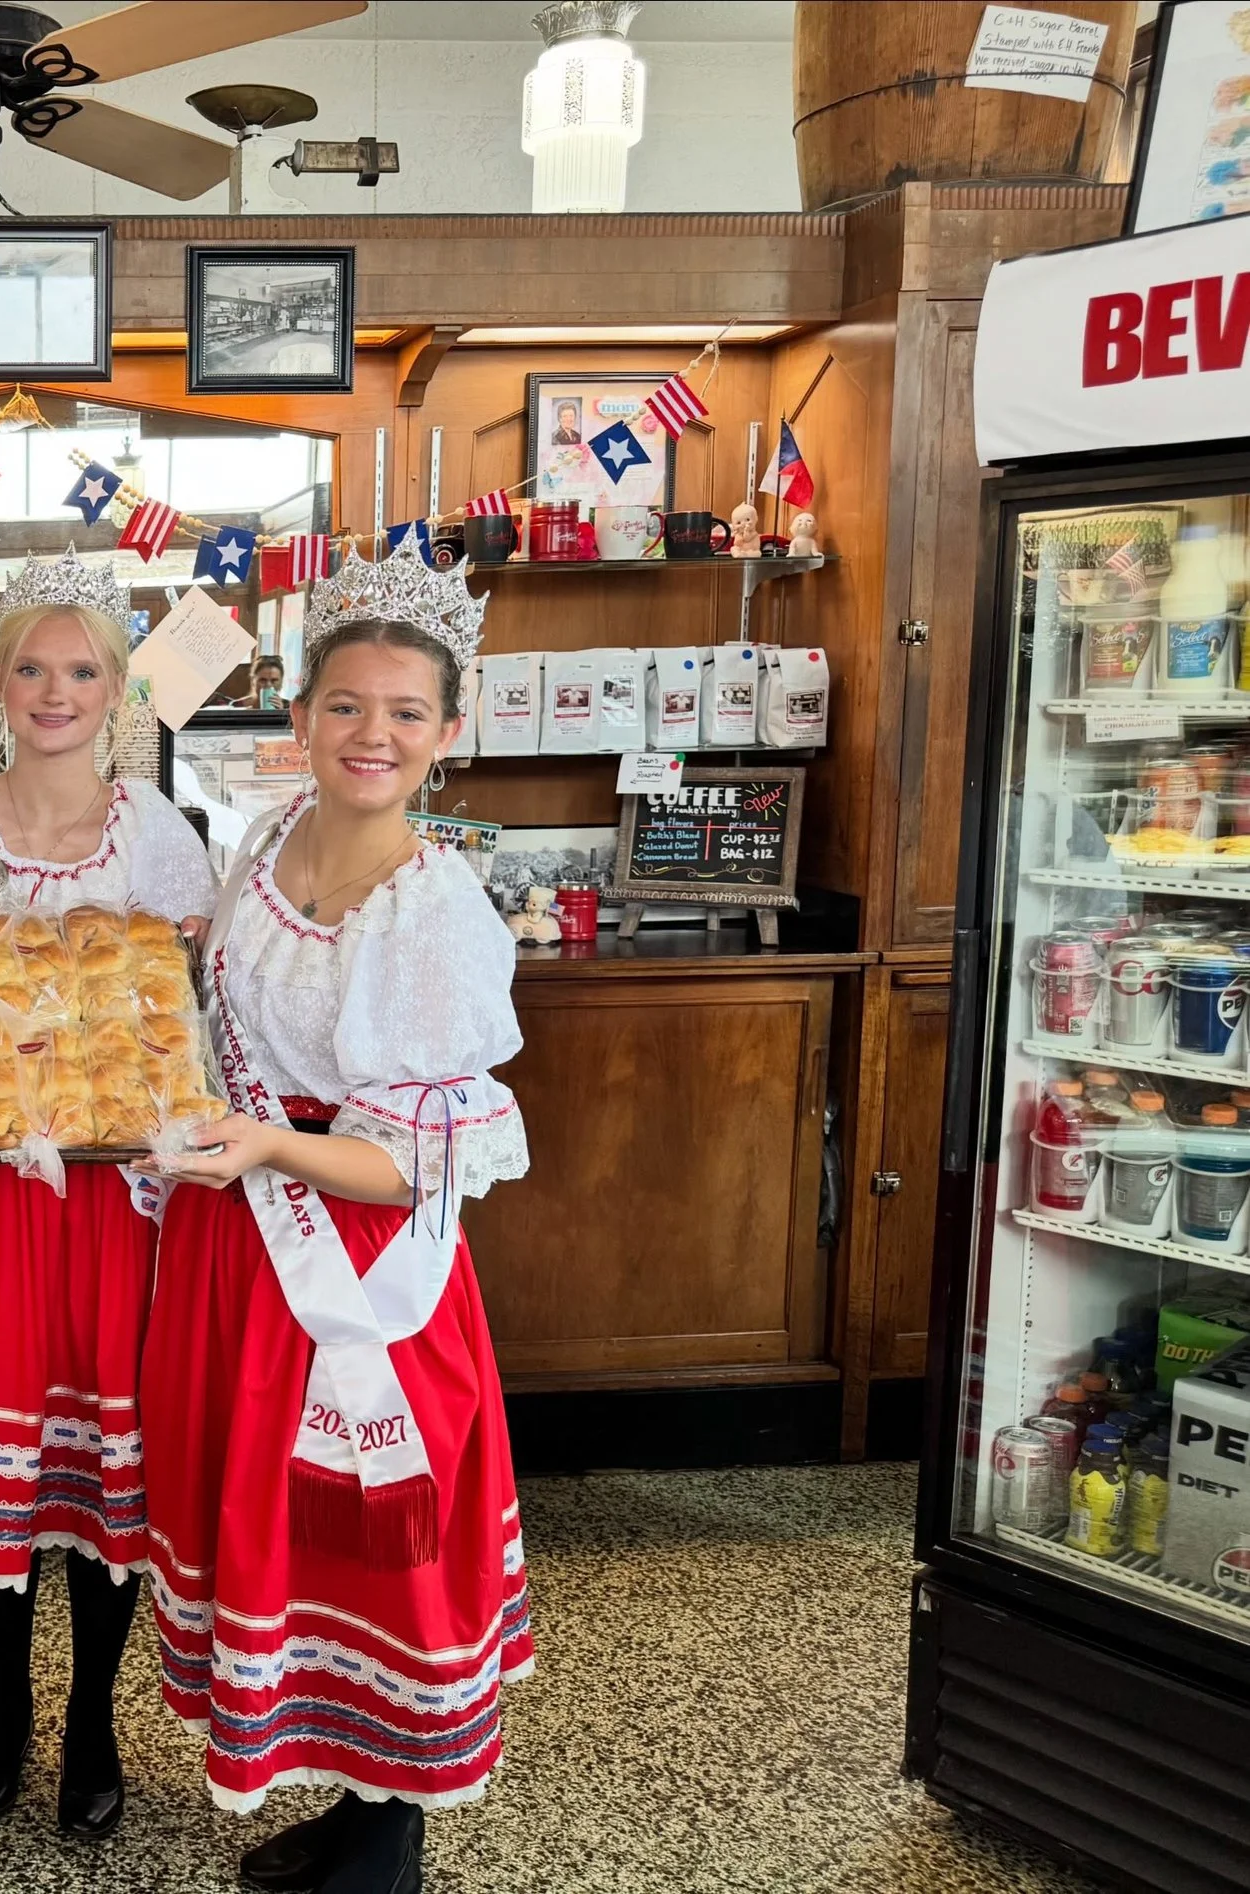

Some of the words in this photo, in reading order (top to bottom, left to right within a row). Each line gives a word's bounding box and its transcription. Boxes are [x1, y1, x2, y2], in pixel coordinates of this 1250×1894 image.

[1028, 16, 1065, 37] Sugar
[1069, 21, 1099, 39] Barrel
[983, 33, 1031, 50] Stamped
[974, 53, 991, 66] We
[1082, 271, 1250, 388] BEV
[636, 756, 659, 765] Beans
[743, 784, 784, 813] New
[650, 805, 661, 814] at
[666, 805, 706, 815] Franke's
[707, 806, 737, 818] Bakery
[426, 822, 463, 837] LOVE
[643, 841, 673, 851] Glazed
[674, 841, 699, 850] Donut
[674, 853, 699, 861] Bread
[213, 945, 249, 1074] MONTGOMERY
[282, 1181, 316, 1237] DAYS
[1162, 1343, 1188, 1361] DO
[356, 1415, 407, 1452] 2027
[1177, 1413, 1250, 1465] PE
[1177, 1472, 1240, 1499] DIET
[1218, 1566, 1250, 1586] PE
